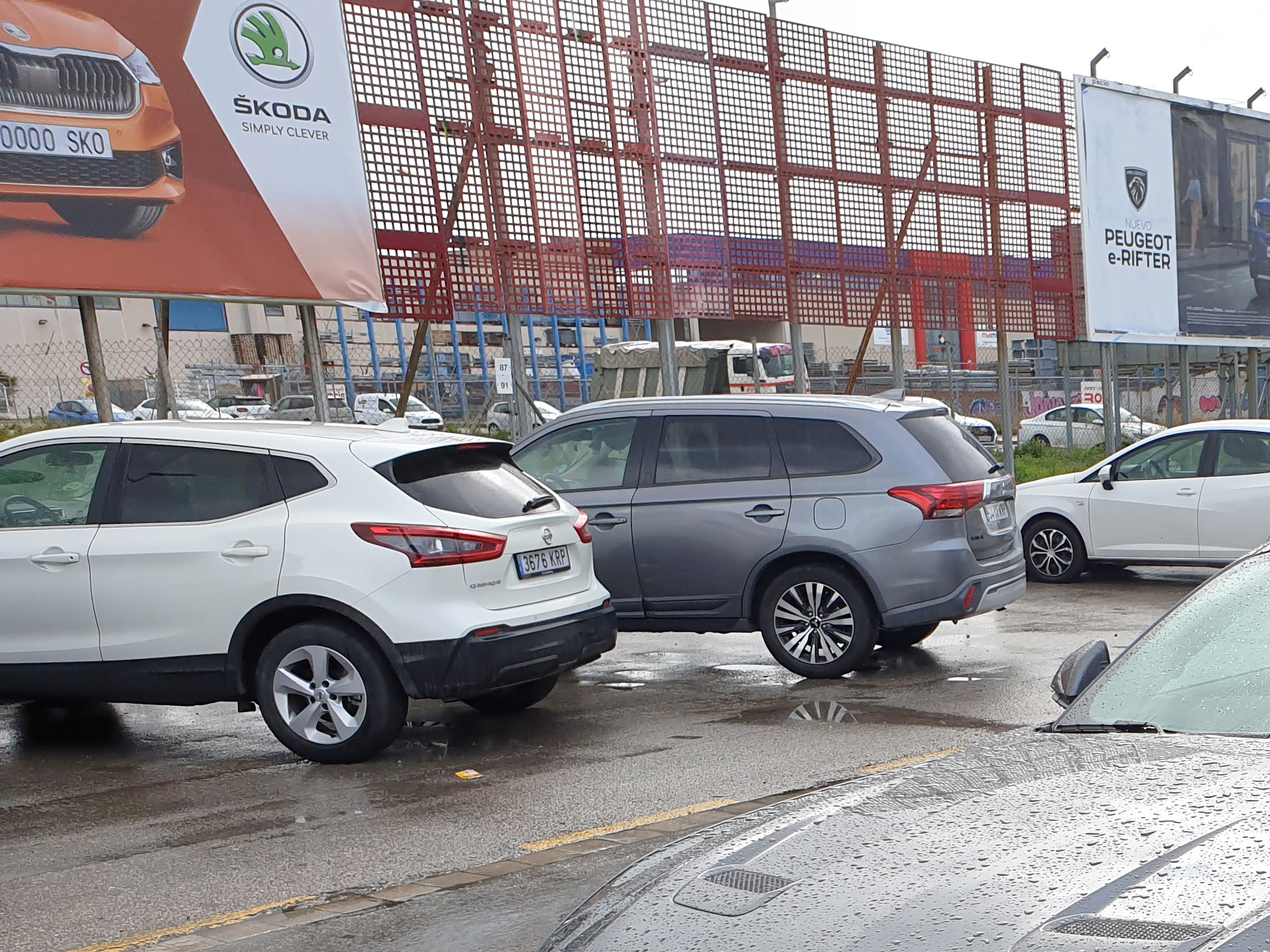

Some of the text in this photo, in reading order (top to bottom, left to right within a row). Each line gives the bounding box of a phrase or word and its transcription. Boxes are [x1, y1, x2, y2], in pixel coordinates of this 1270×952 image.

[233, 93, 332, 124] ŠKODA
[0, 124, 56, 152] 0000
[241, 121, 330, 141] SIMPLY CLEVER
[1125, 218, 1152, 231] NUEVO
[1104, 228, 1173, 252] PEUGEOT
[1107, 248, 1171, 270] e-RIFTER
[500, 381, 509, 389] 91
[523, 548, 566, 572] 3676 KRP
